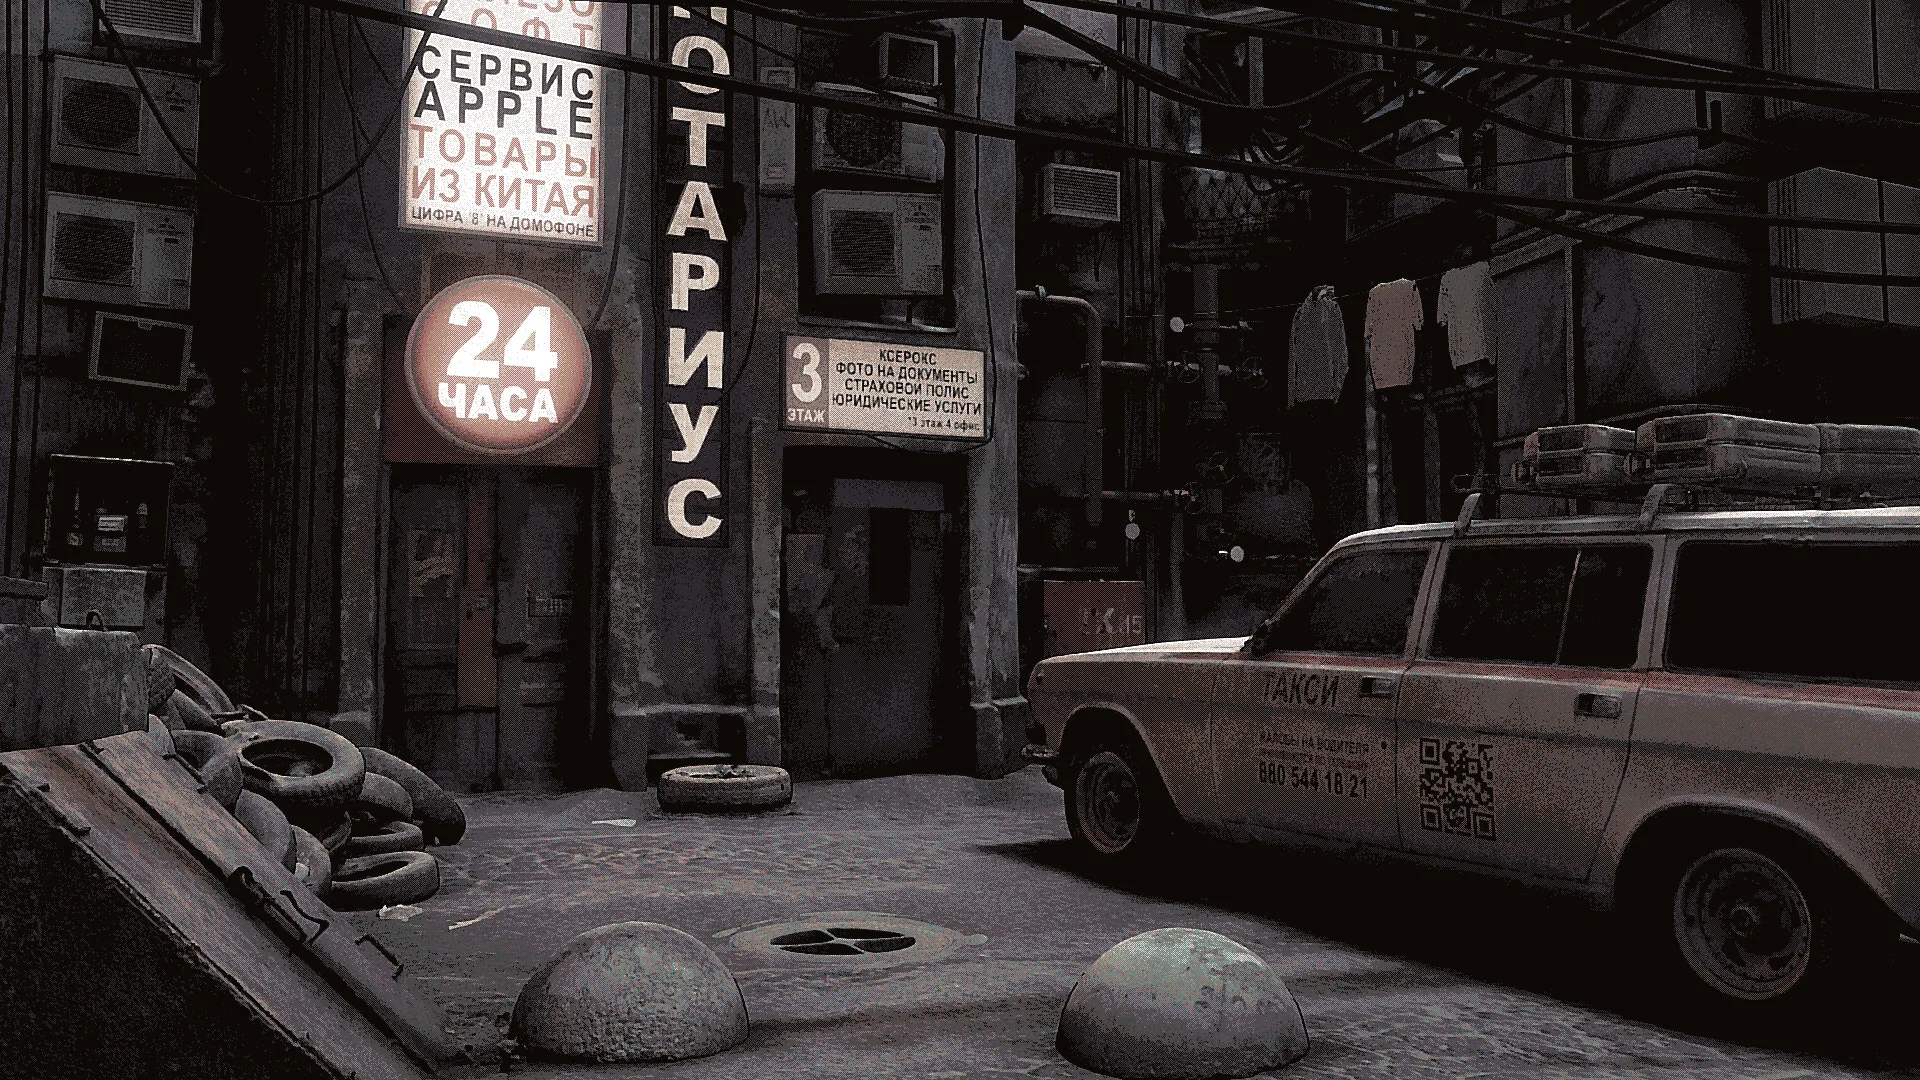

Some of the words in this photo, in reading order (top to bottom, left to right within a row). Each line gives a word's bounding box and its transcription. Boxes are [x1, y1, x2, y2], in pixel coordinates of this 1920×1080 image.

[417, 44, 594, 101] СЕРВИС
[413, 80, 594, 140] APPLE
[409, 123, 596, 179] ТОВАРЫ
[411, 165, 461, 204] ИЗ
[474, 172, 595, 218] КИТАЯ
[411, 205, 464, 224] ЦИФРА
[486, 214, 507, 230] НА
[509, 216, 595, 238] ДОМОФОНЕ
[666, 5, 730, 539] ОТАРИУС
[446, 300, 558, 382] 24
[879, 348, 938, 366] КСЕРОКС
[791, 342, 823, 403] 3
[835, 361, 874, 377] ФОТО
[877, 364, 895, 378] НА
[898, 366, 979, 384] ДОКУМЕНТЫ
[438, 382, 559, 424] ЧАСА
[831, 392, 931, 412] ЮРИДИЧЕСКИЕ
[934, 400, 982, 416] УСЛУГИ
[926, 383, 970, 400] ПОЛИС
[786, 407, 826, 424] ЭТАЖ
[945, 418, 952, 429] 4
[1262, 671, 1340, 708] ТАКСИ
[1291, 766, 1320, 791] 544
[1324, 771, 1344, 796] 18
[1349, 774, 1368, 799] 21
